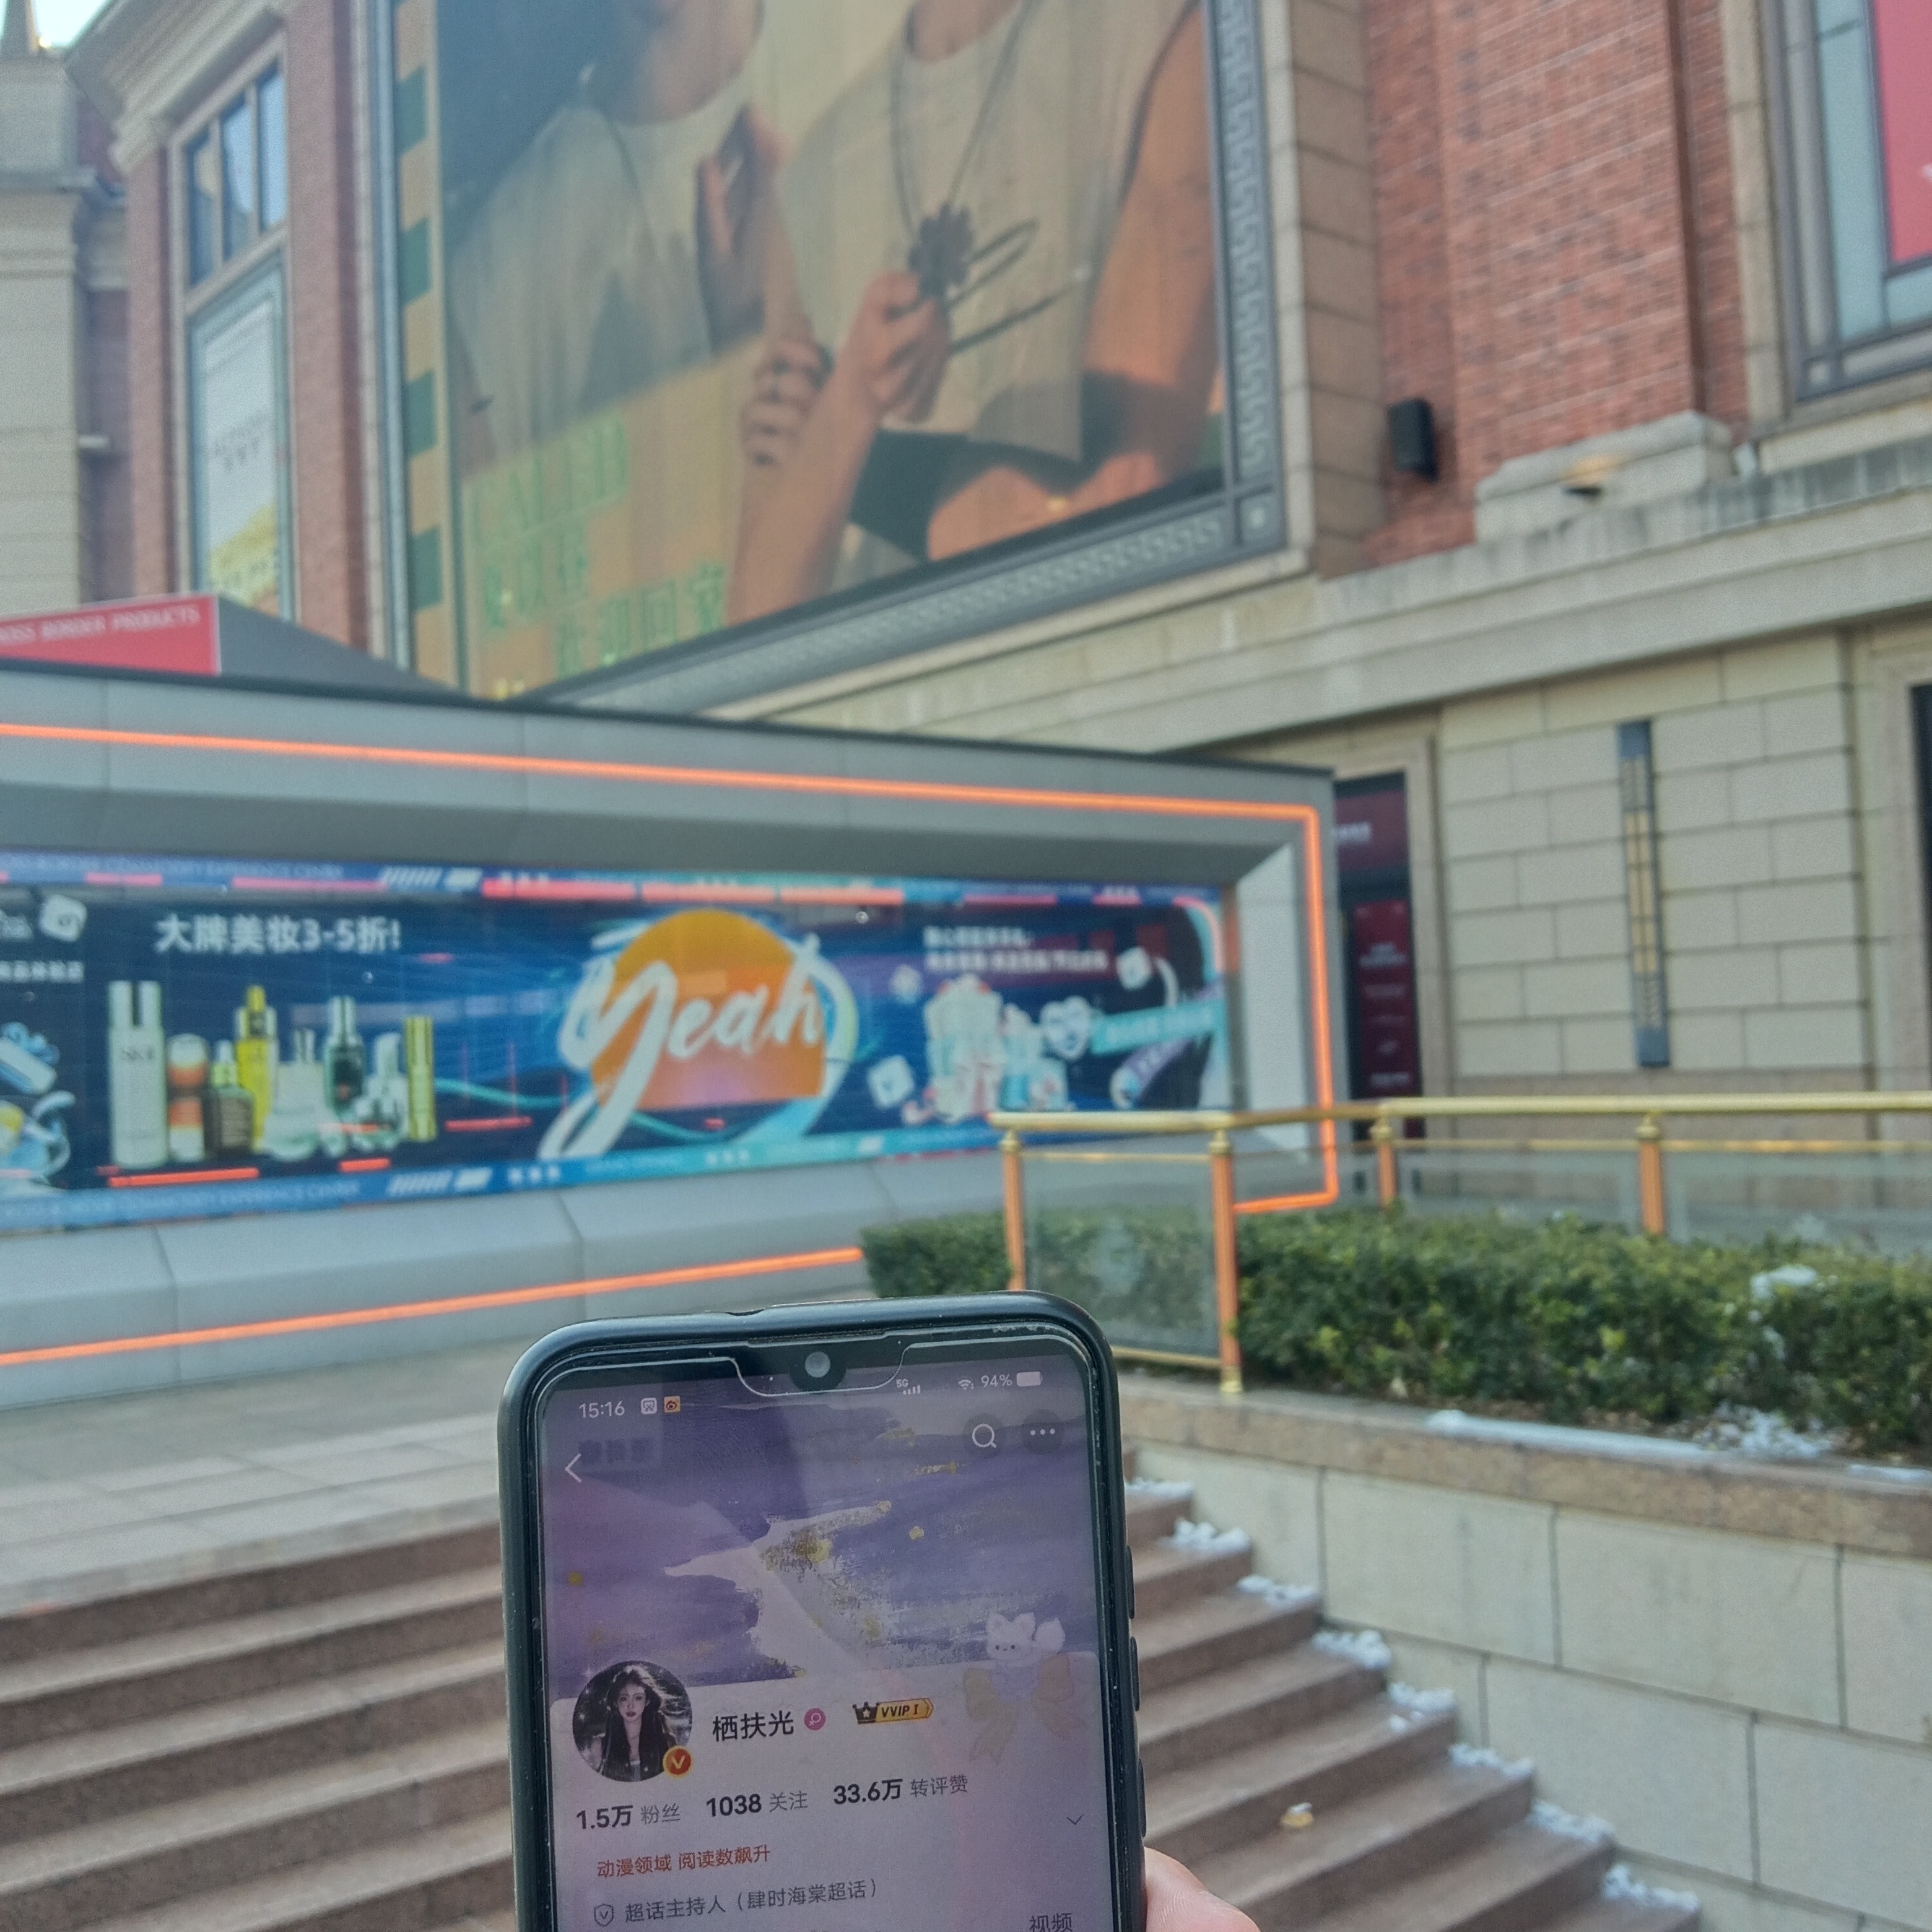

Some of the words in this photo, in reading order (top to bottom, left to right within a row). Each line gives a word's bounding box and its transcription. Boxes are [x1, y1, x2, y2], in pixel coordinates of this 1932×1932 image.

[155, 913, 401, 954] 大牌美妆3-5折!
[896, 1378, 908, 1388] 5G
[981, 1374, 1013, 1388] 94%
[578, 1400, 625, 1419] 15:16
[881, 1705, 910, 1718] VVIP
[712, 1710, 794, 1742] 栖扶光
[833, 1778, 903, 1805] 33.6万
[910, 1774, 968, 1797] 转评赞
[706, 1793, 762, 1817] 1038
[769, 1790, 809, 1812] 关注
[576, 1804, 634, 1830] 1.5万
[640, 1803, 681, 1825] 粉丝
[597, 1853, 672, 1878] 动漫领域
[1029, 1912, 1073, 1932] 视频
